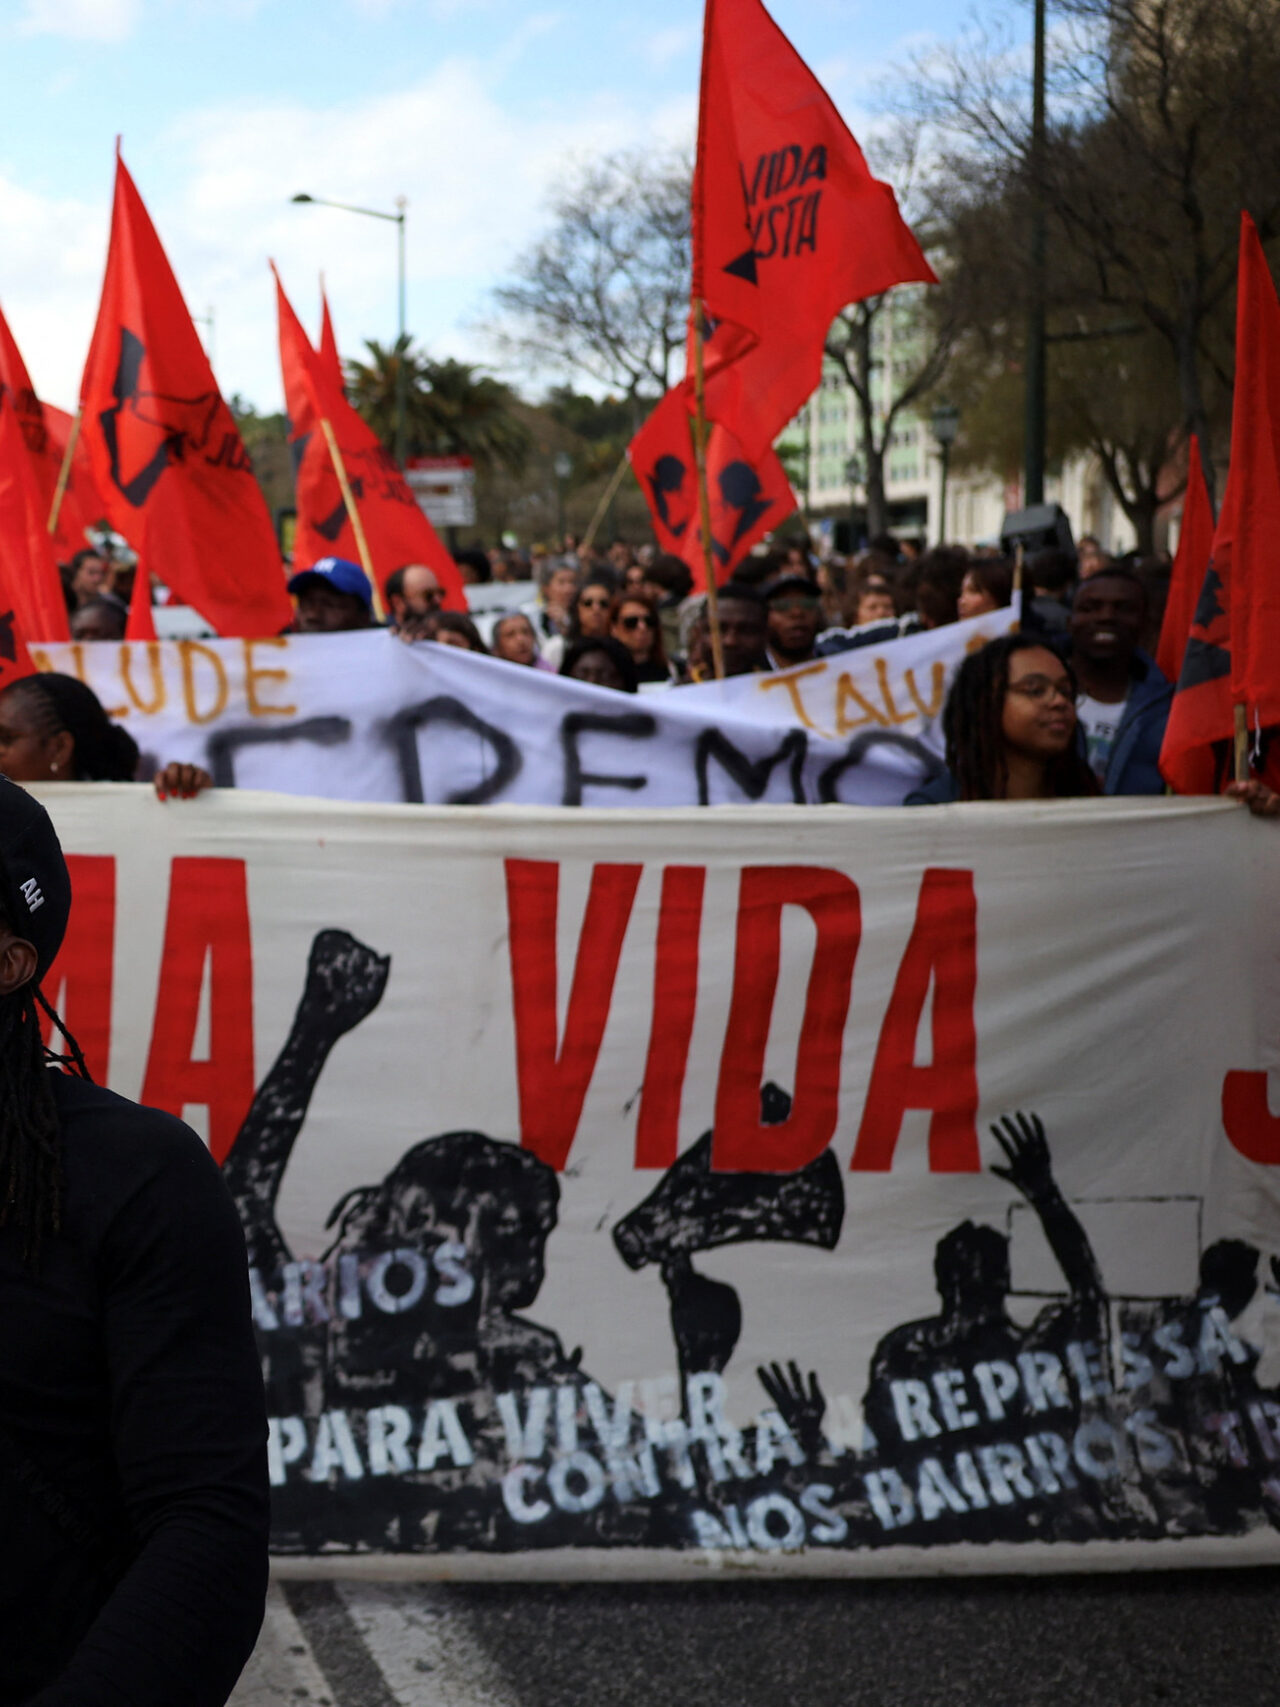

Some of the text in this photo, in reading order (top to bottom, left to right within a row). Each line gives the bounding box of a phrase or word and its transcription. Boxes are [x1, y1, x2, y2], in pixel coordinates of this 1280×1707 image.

[738, 144, 827, 206] VIDA
[34, 637, 295, 724] LUDE
[19, 878, 46, 914] AH
[504, 858, 982, 1173] VIDA
[268, 1400, 475, 1487] PARA
[689, 1484, 848, 1551] NOS
